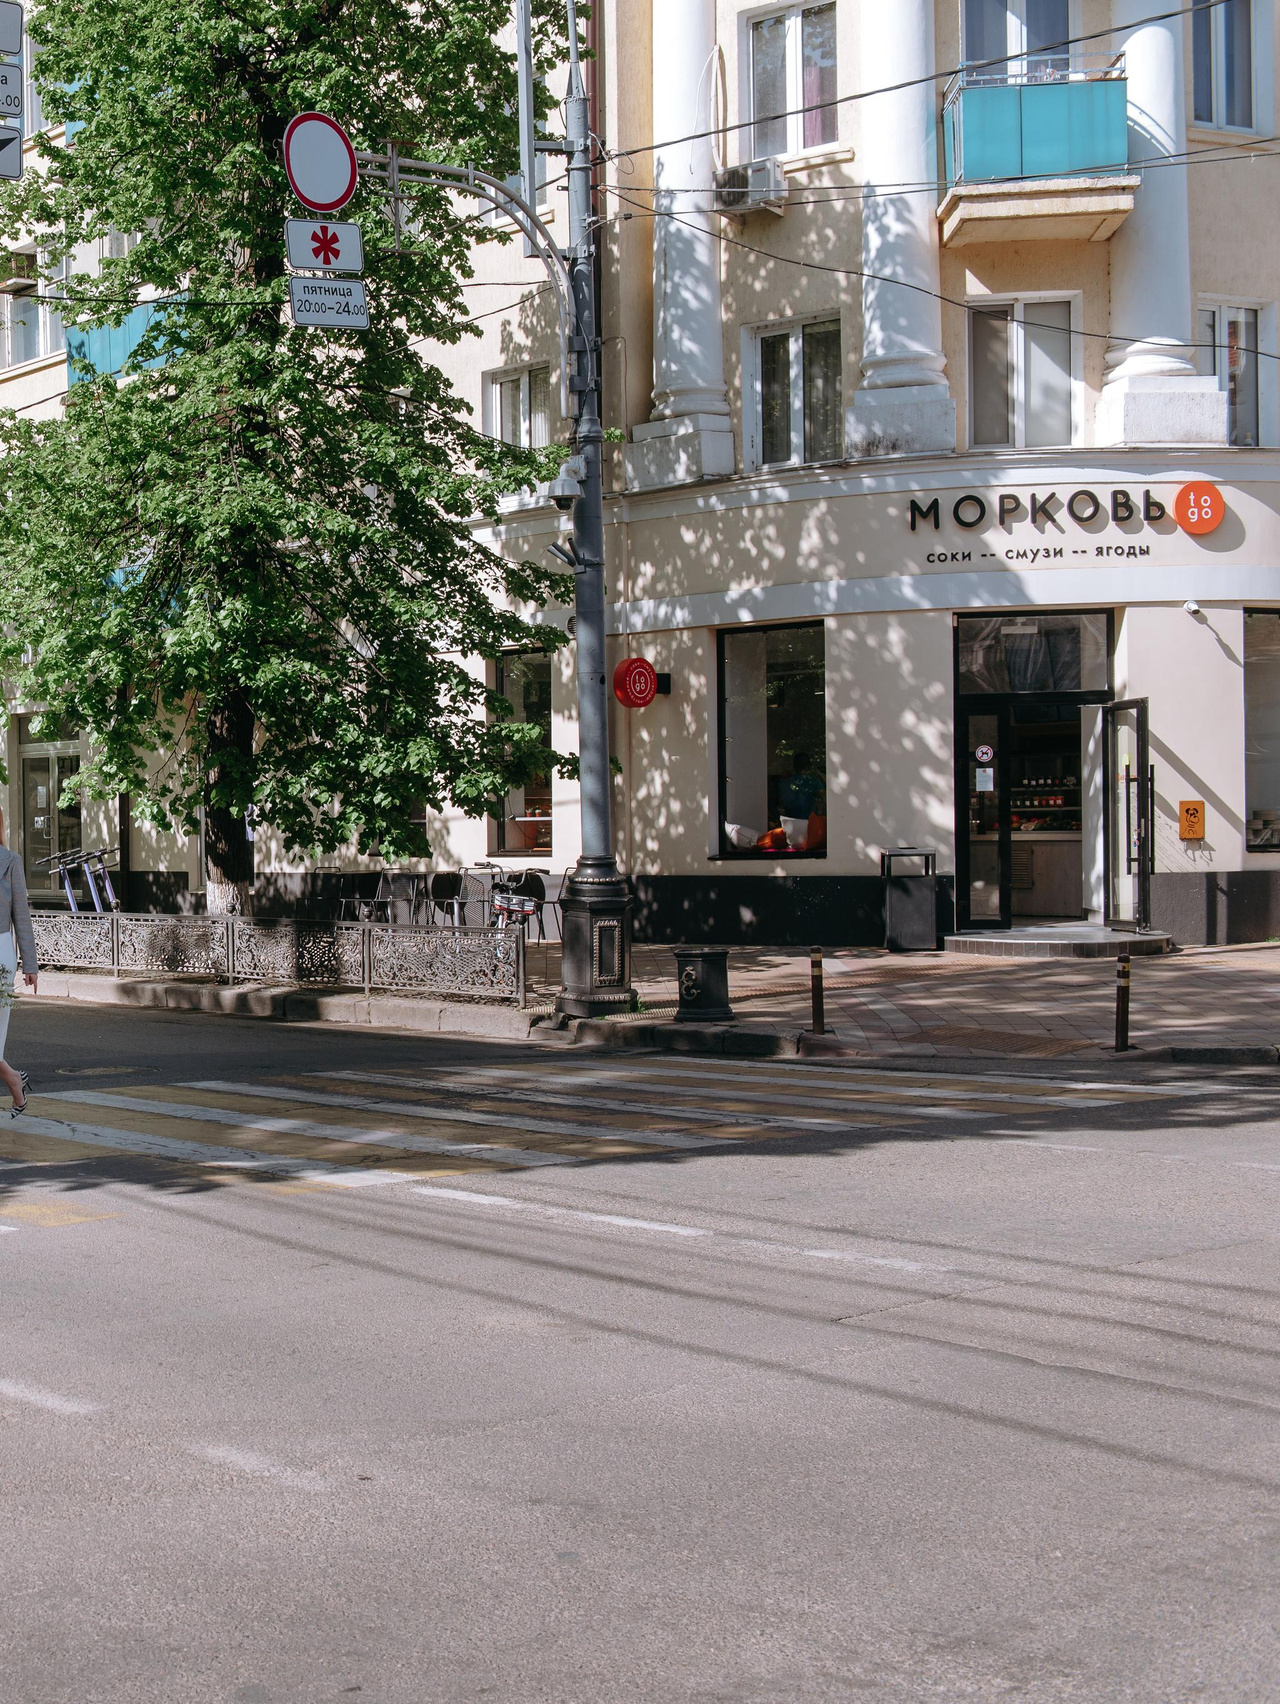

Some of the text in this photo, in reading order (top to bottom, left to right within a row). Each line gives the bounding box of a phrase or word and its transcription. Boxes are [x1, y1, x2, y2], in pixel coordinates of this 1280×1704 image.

[303, 285, 353, 298] пятница
[1189, 491, 1212, 507] to
[909, 488, 1166, 532] МОРКОВЬ
[1187, 507, 1212, 522] go
